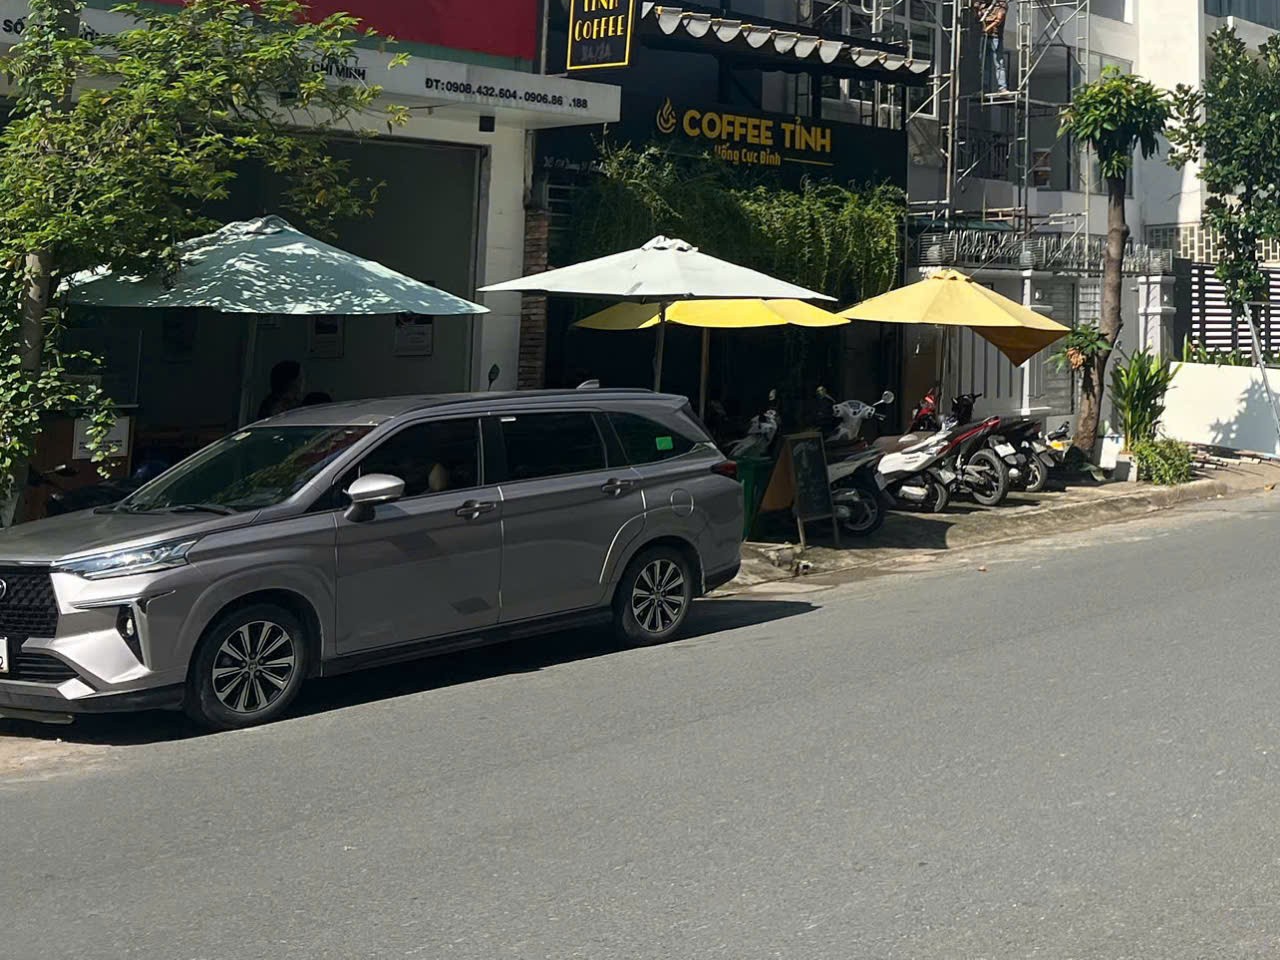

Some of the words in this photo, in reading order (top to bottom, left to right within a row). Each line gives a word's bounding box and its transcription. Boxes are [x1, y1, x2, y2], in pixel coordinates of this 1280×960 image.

[574, 14, 625, 41] COFFEE
[682, 109, 774, 147] COFFEE
[781, 116, 832, 153] TỈNH
